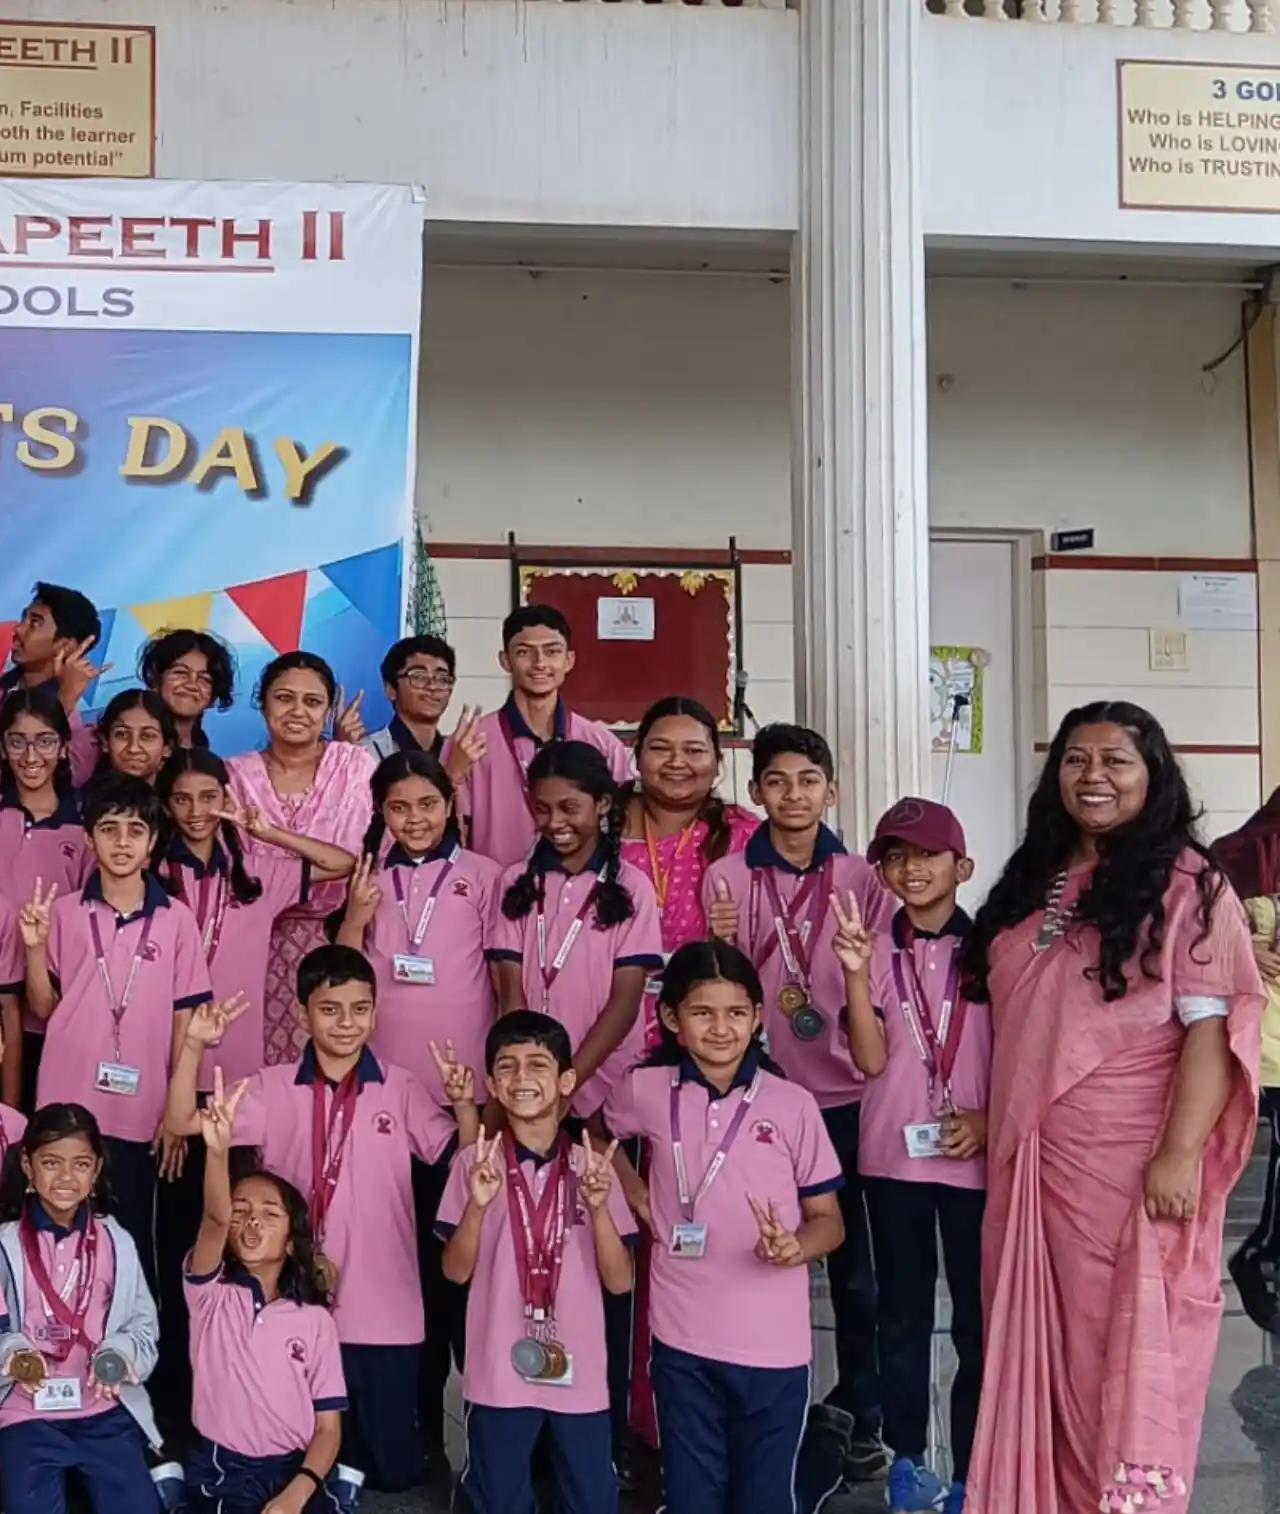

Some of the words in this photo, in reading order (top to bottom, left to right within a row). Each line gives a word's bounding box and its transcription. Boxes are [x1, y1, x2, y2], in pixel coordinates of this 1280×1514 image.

[1212, 79, 1227, 100] 3
[1236, 80, 1280, 101] GO
[20, 100, 103, 119] Facilities
[1127, 108, 1170, 126] Who
[1177, 110, 1192, 126] is
[36, 125, 65, 141] the
[71, 126, 136, 144] learner
[1149, 132, 1192, 150] Who
[1198, 134, 1213, 151] is
[1220, 135, 1280, 153] LOVIN
[1129, 156, 1173, 173] Who
[1179, 158, 1194, 174] is
[119, 416, 341, 498] DAY
